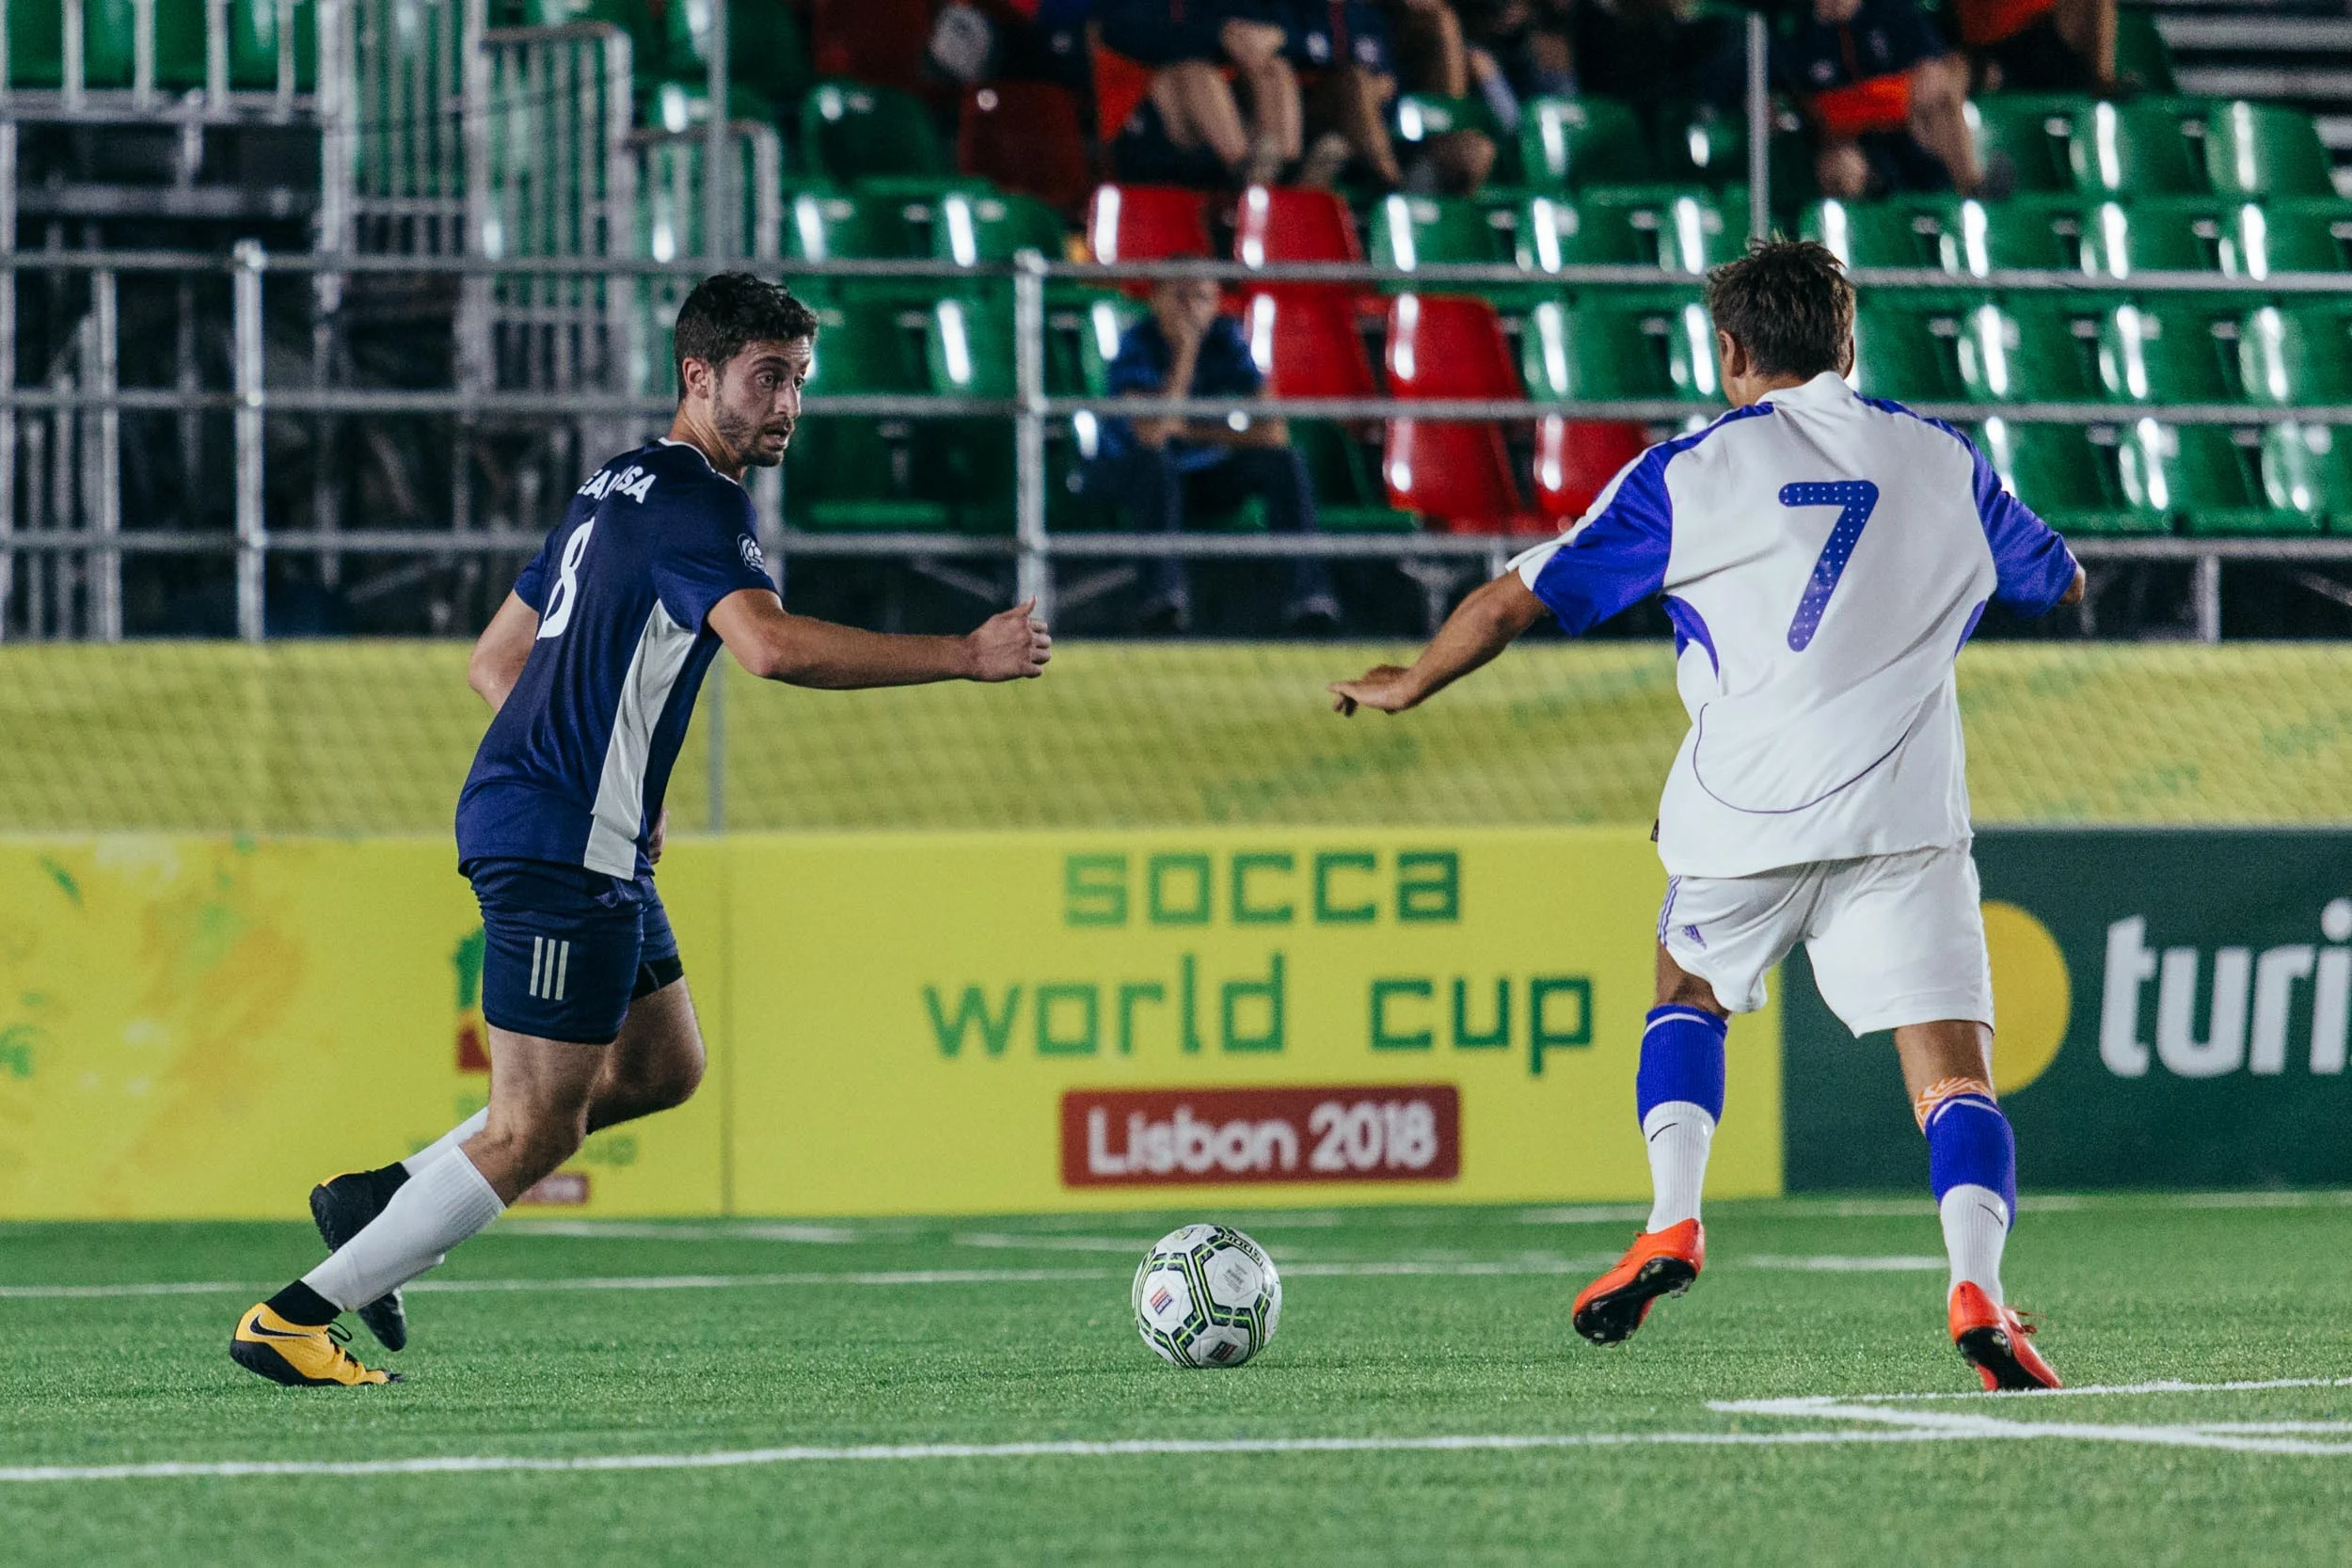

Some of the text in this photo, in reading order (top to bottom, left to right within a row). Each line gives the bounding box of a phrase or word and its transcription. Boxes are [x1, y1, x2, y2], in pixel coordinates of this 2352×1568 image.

[536, 516, 595, 641] 8
[1778, 481, 1880, 652] 7
[1064, 852, 1460, 926] socca
[922, 950, 1593, 1077] world cup
[2099, 897, 2352, 1078] turi
[1088, 1101, 1437, 1175] Lisbon 2018
